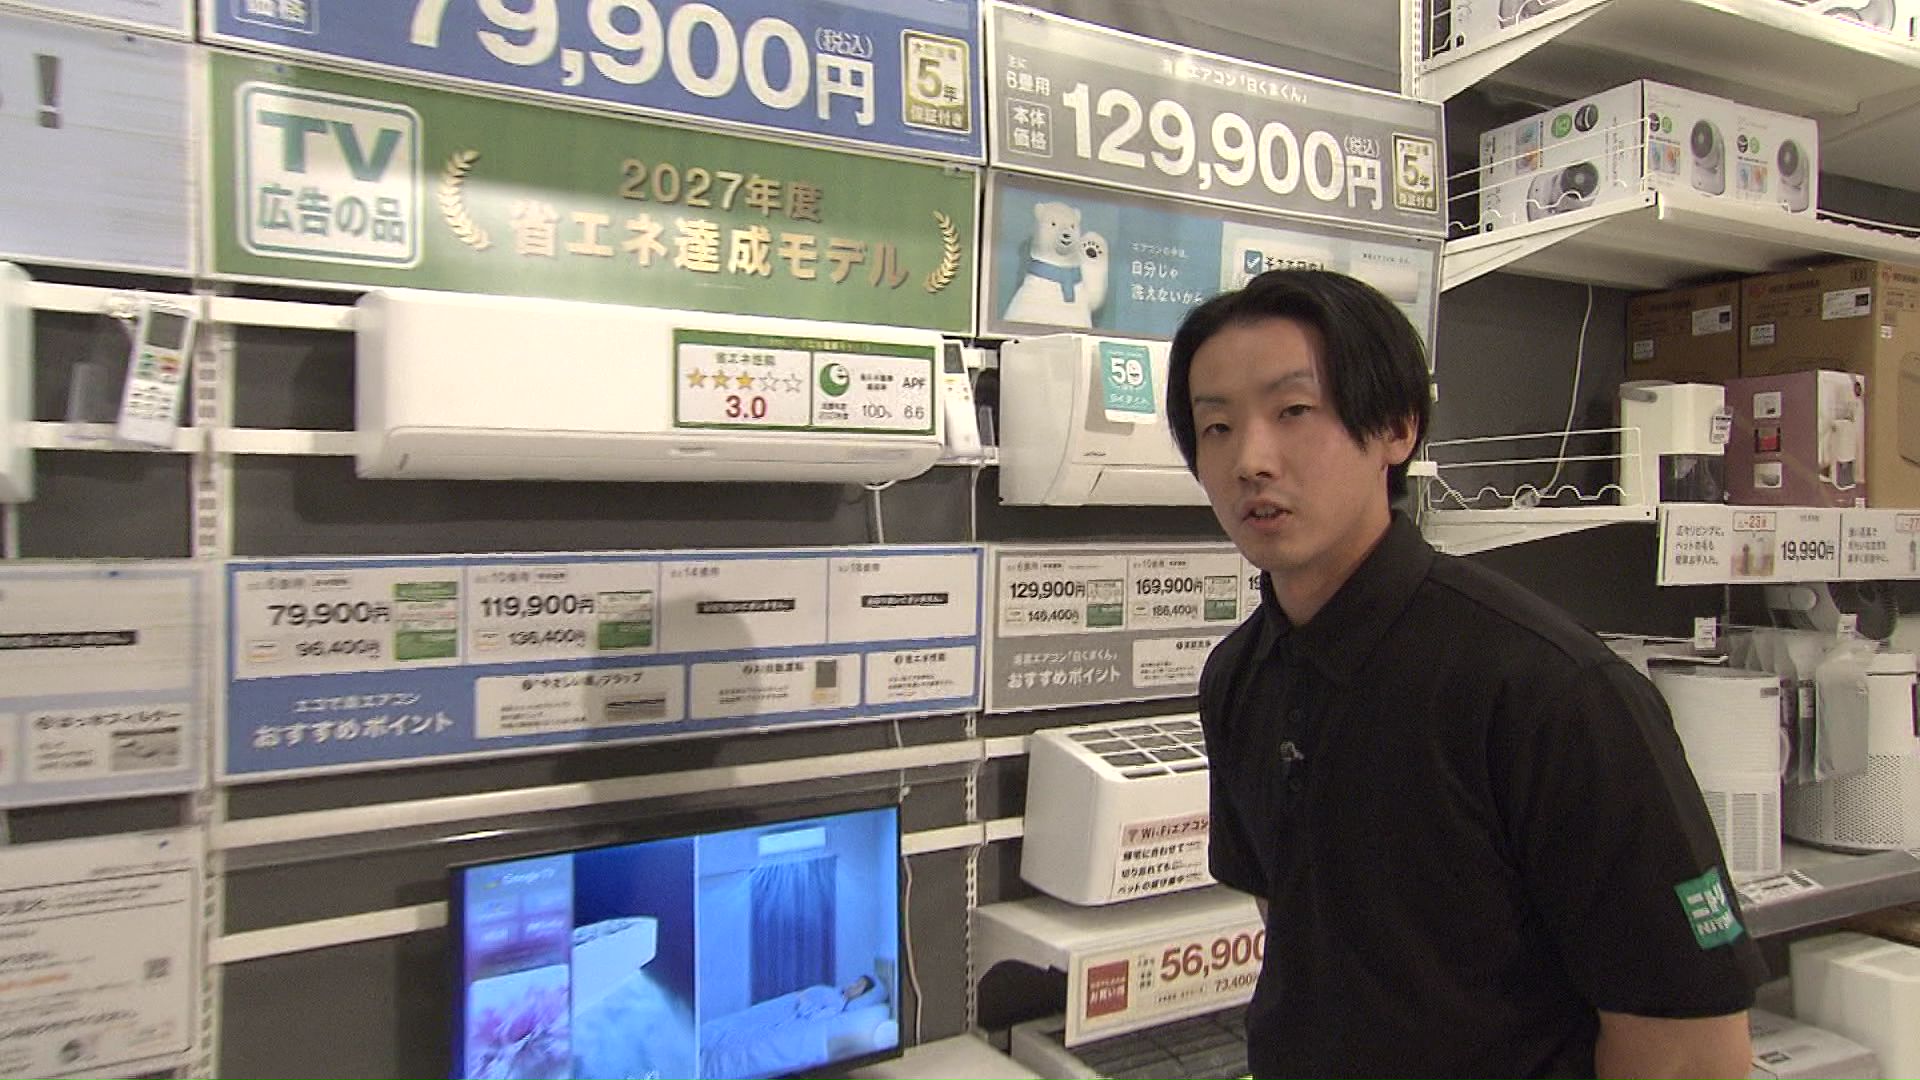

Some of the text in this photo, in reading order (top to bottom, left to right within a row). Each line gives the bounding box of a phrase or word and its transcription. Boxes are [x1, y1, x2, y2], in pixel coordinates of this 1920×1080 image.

[258, 110, 402, 182] TV
[1062, 82, 1383, 210] 129,900円
[619, 158, 824, 223] 2027年度
[259, 183, 404, 244] 広告の品
[509, 202, 909, 290] 省エネ達成モデル
[1132, 260, 1179, 279] 自分じゃ
[725, 395, 768, 418] 3.0
[1781, 541, 1835, 561] 19,990円
[1010, 580, 1085, 600] 129,900円
[1136, 577, 1202, 596] 169,900円
[481, 594, 594, 618] 119,900円
[1008, 665, 1121, 689] おすすめポイント
[253, 712, 454, 749] おすすめポイント
